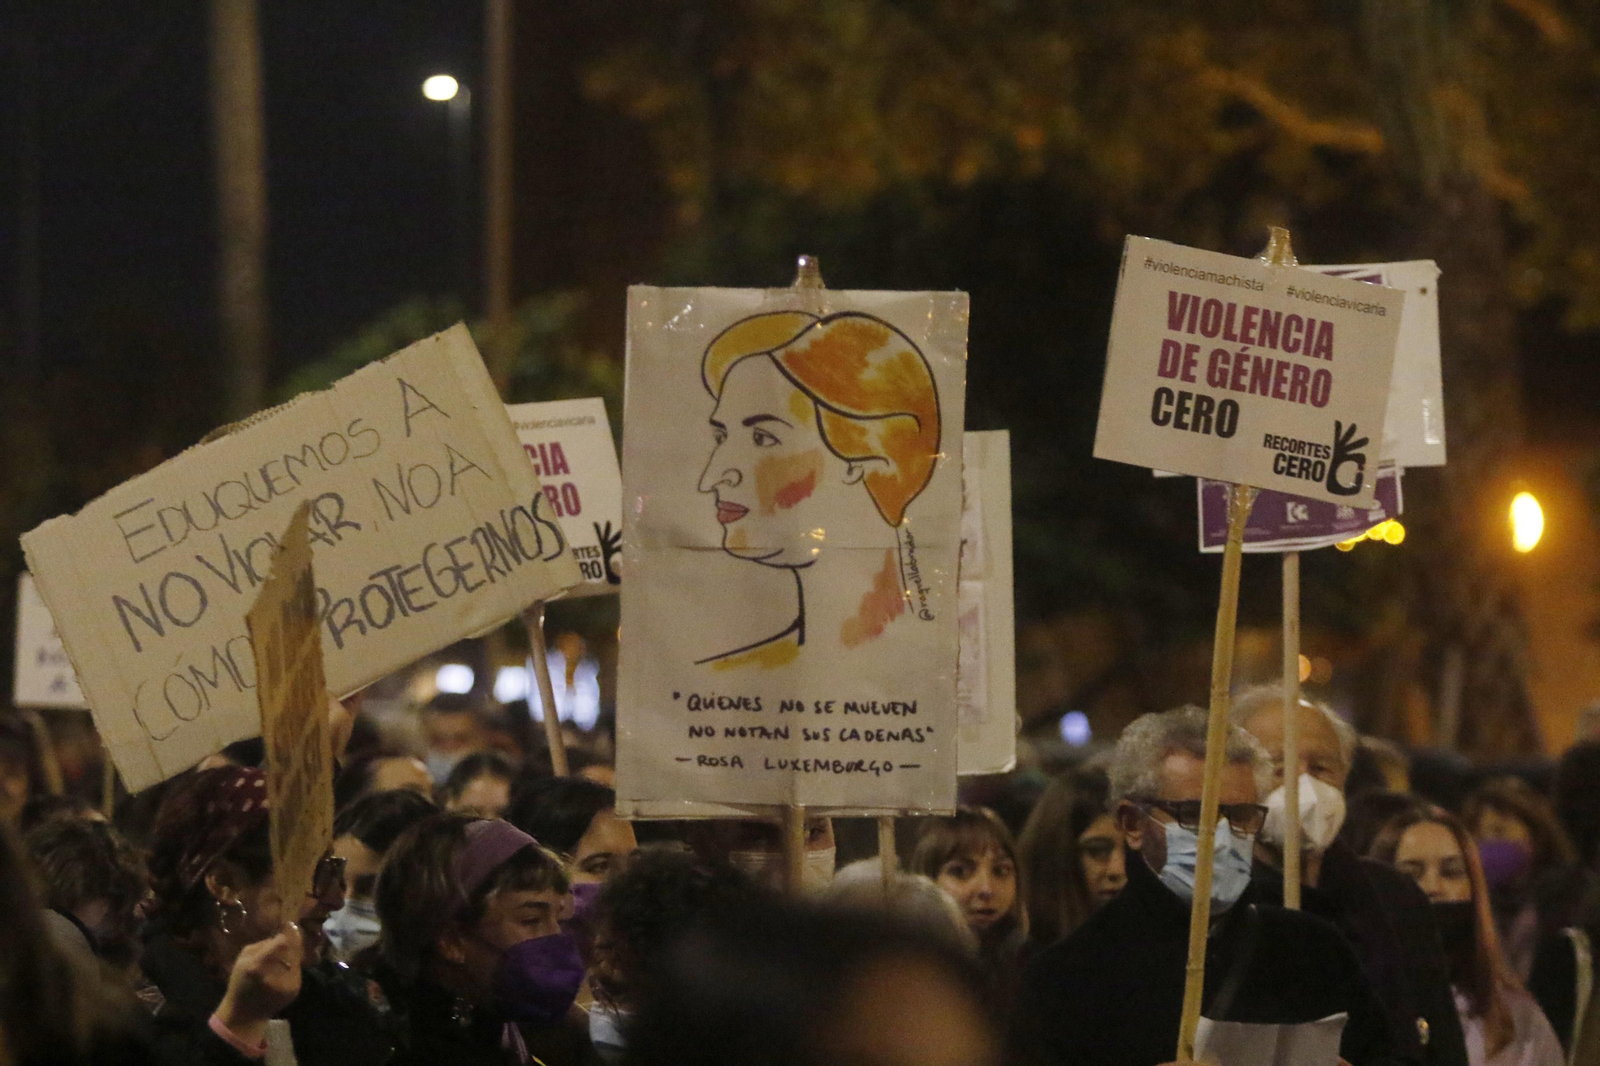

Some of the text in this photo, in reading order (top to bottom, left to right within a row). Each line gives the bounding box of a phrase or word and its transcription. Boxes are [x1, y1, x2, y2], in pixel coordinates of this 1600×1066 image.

[1143, 256, 1387, 317] #violenciamachista #violenciavicaria
[1167, 290, 1335, 362] VIOLENCIA
[1157, 338, 1333, 408] DE GÉNERO
[1151, 386, 1240, 439] CERO
[113, 377, 451, 564] EDUQUEMOS A
[1263, 432, 1332, 460] RECORTES
[1272, 453, 1326, 484] CERO
[112, 571, 208, 653] NO
[372, 462, 442, 521] NO
[444, 443, 493, 496] A
[688, 725, 716, 739] NO
[724, 725, 790, 741] NOTAN
[802, 727, 831, 742] SUS
[779, 700, 805, 715] NO
[814, 700, 838, 714] SE
[843, 699, 918, 717] MUEVEN
